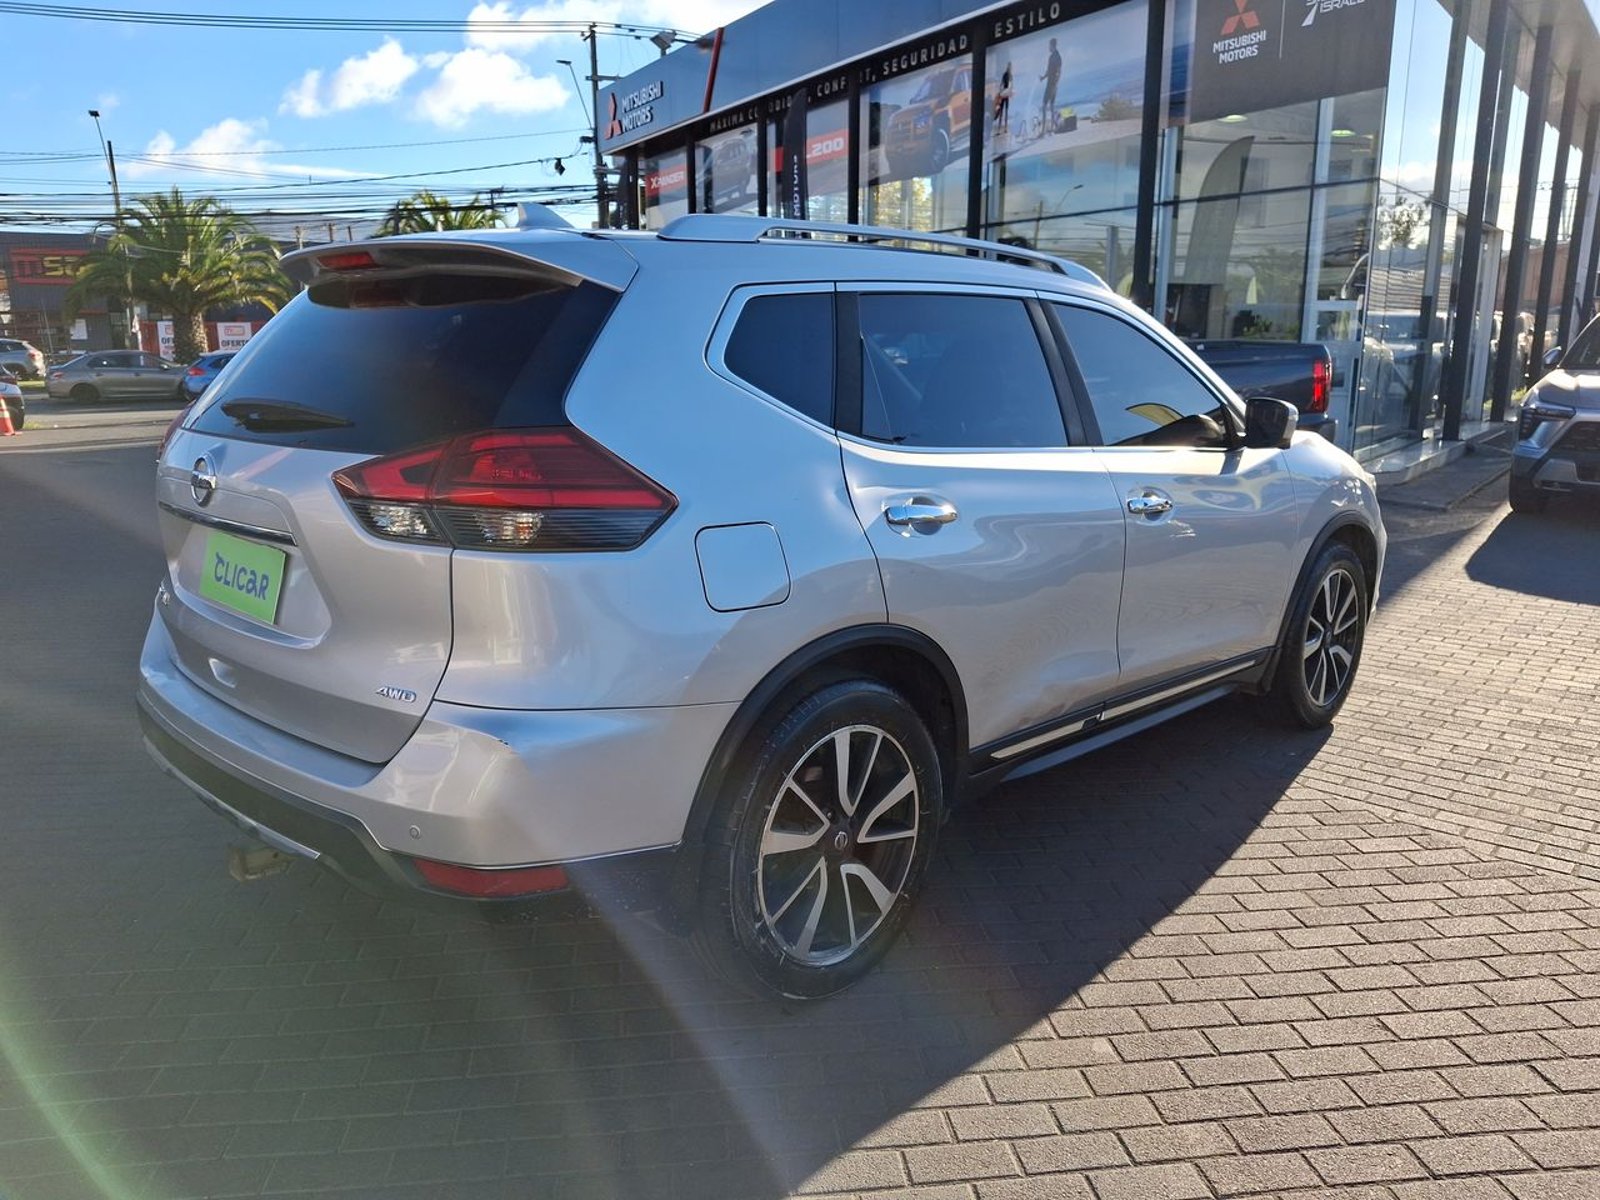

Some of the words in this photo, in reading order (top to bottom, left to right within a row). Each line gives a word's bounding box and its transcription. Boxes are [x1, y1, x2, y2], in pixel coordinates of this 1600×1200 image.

[883, 34, 968, 76] SEGURIDAD
[994, 2, 1060, 38] ESTILO
[1212, 30, 1267, 53] MITSUBISHI
[1218, 44, 1259, 64] MOTORS
[622, 80, 664, 113] MITSUBISHI
[622, 105, 653, 132] MOTORS
[375, 685, 417, 703] 4WD
